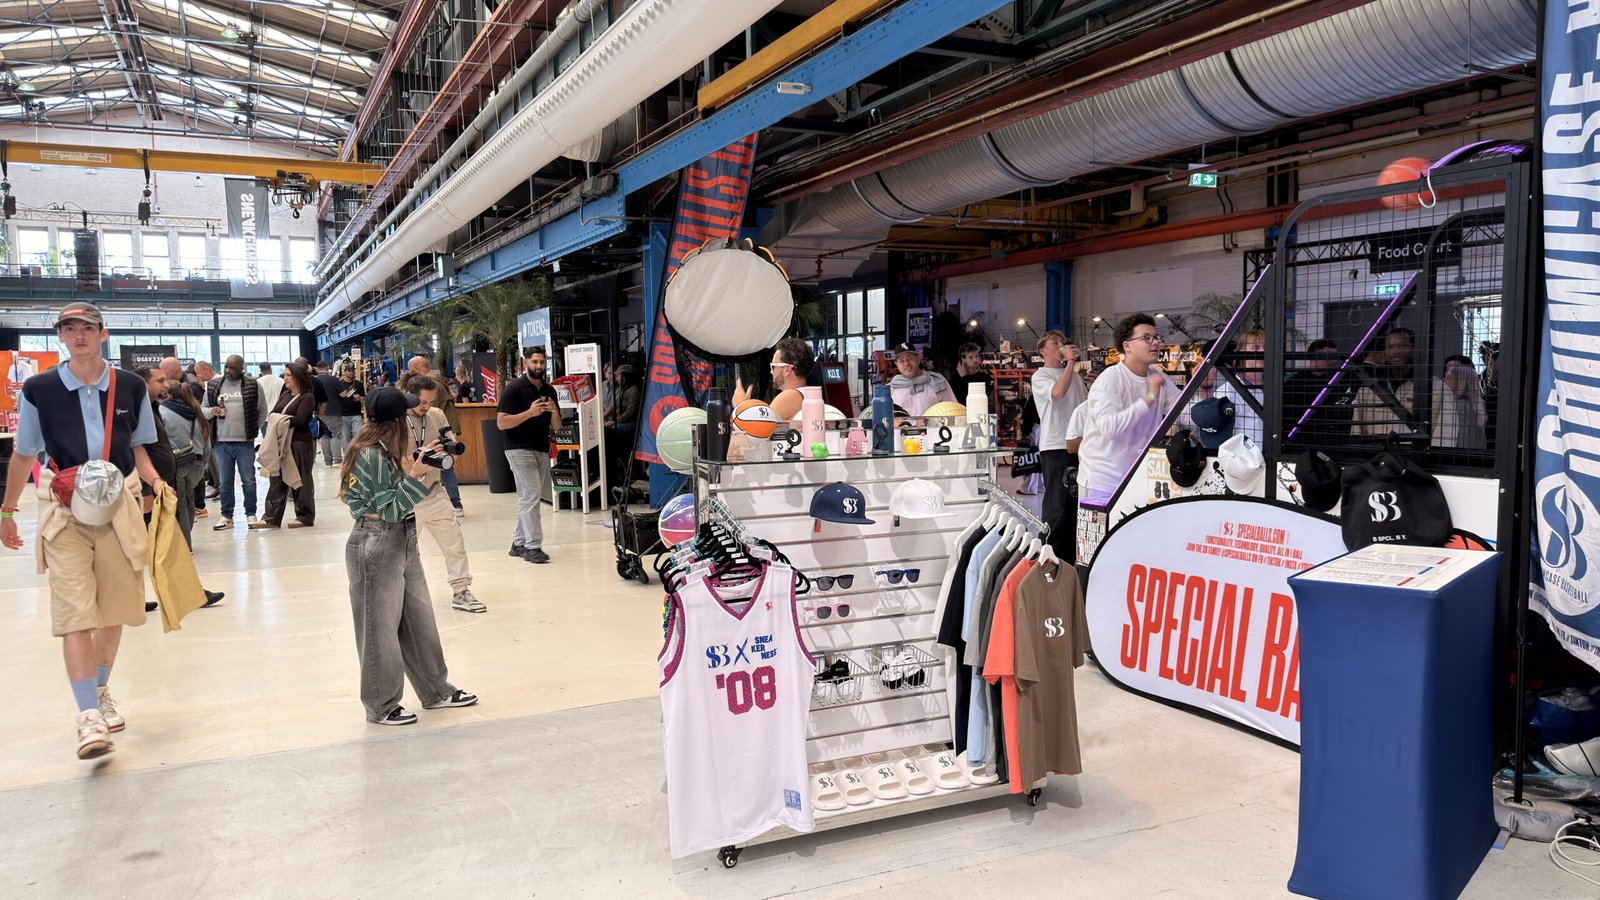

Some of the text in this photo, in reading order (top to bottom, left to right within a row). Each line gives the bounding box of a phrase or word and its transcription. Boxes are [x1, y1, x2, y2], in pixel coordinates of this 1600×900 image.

[1378, 240, 1452, 259] Food Cort
[527, 319, 545, 338] TOKENS
[481, 372, 497, 404] Bud
[1237, 523, 1285, 545] SPECIALBALLS.COM
[1293, 549, 1303, 559] BALL
[755, 634, 773, 645] SNEA
[1120, 563, 1253, 703] SPECIAL
[751, 644, 766, 653] KER
[715, 665, 777, 715] '08
